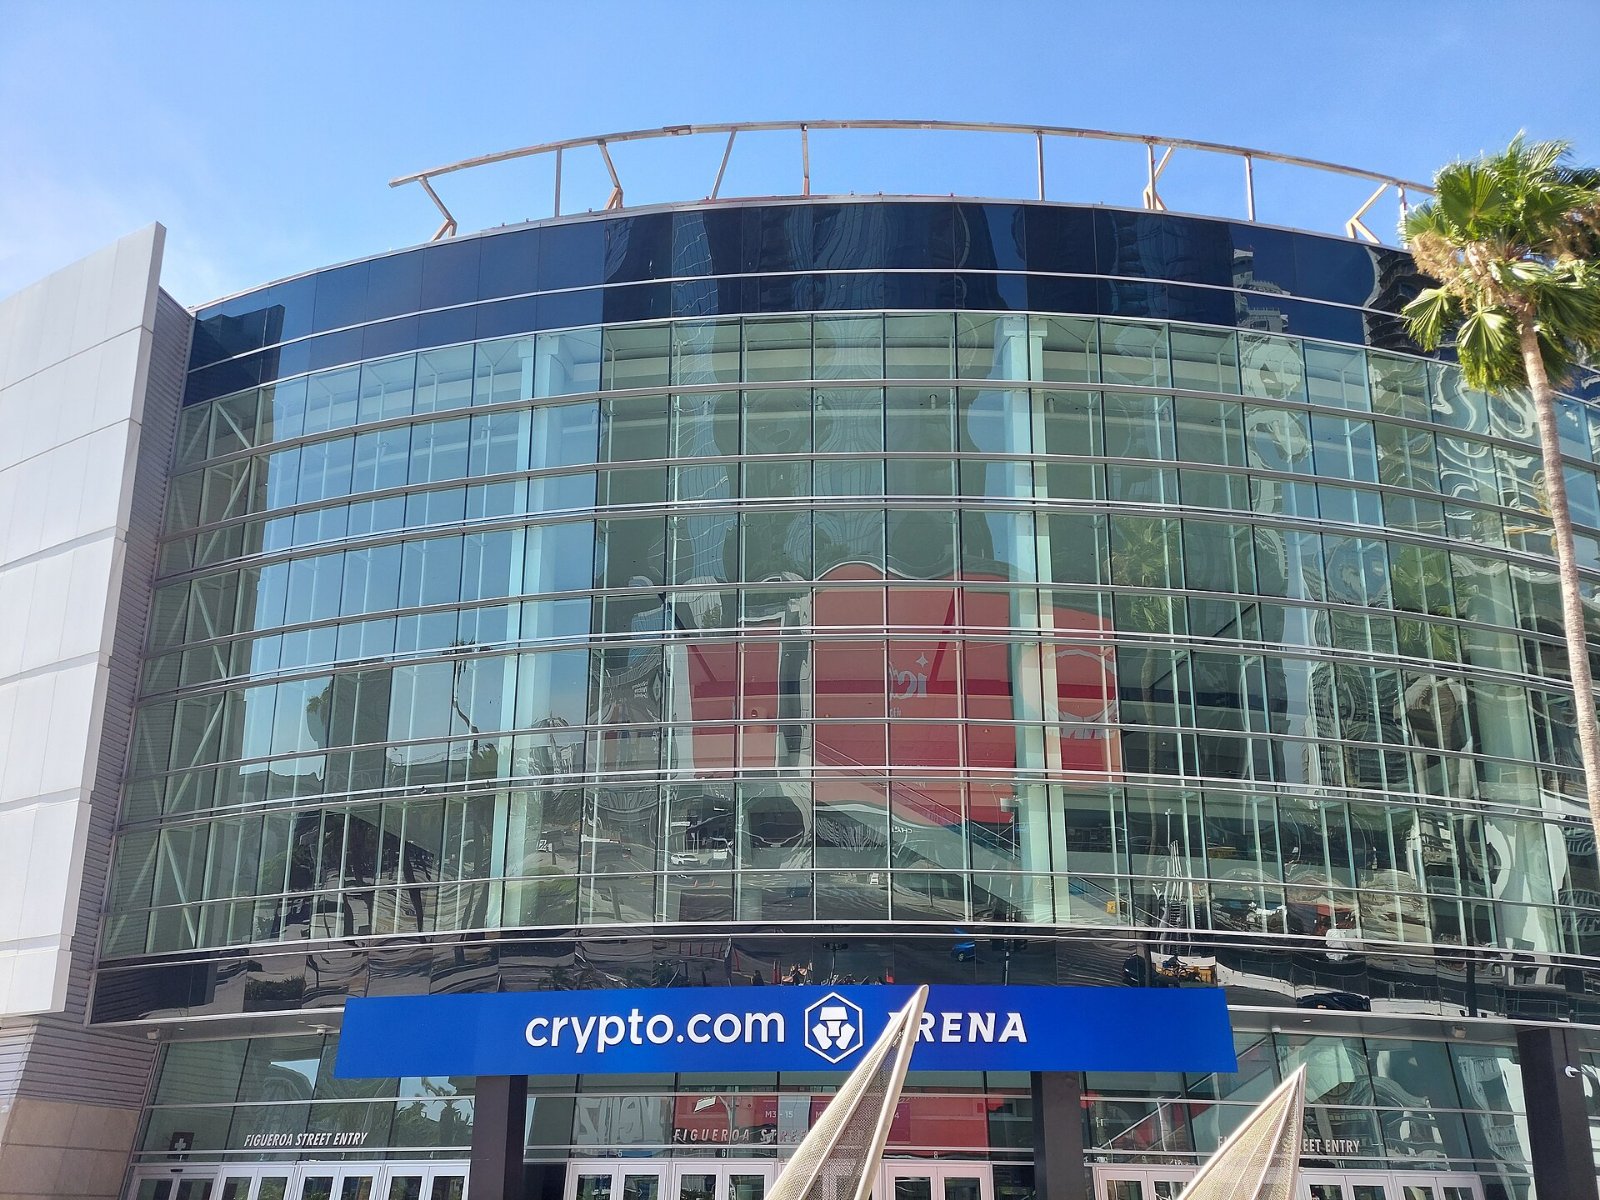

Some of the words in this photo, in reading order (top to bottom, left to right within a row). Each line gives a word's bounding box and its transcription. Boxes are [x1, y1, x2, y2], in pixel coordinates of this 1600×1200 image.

[525, 1008, 785, 1053] crypto.com
[888, 1012, 1027, 1043] RENA
[244, 1133, 293, 1147] FIGUEROA
[295, 1132, 333, 1146] STREET
[332, 1131, 368, 1146] ENTRY
[673, 1128, 750, 1142] FIGUEROA
[1325, 1139, 1360, 1153] ENTRY
